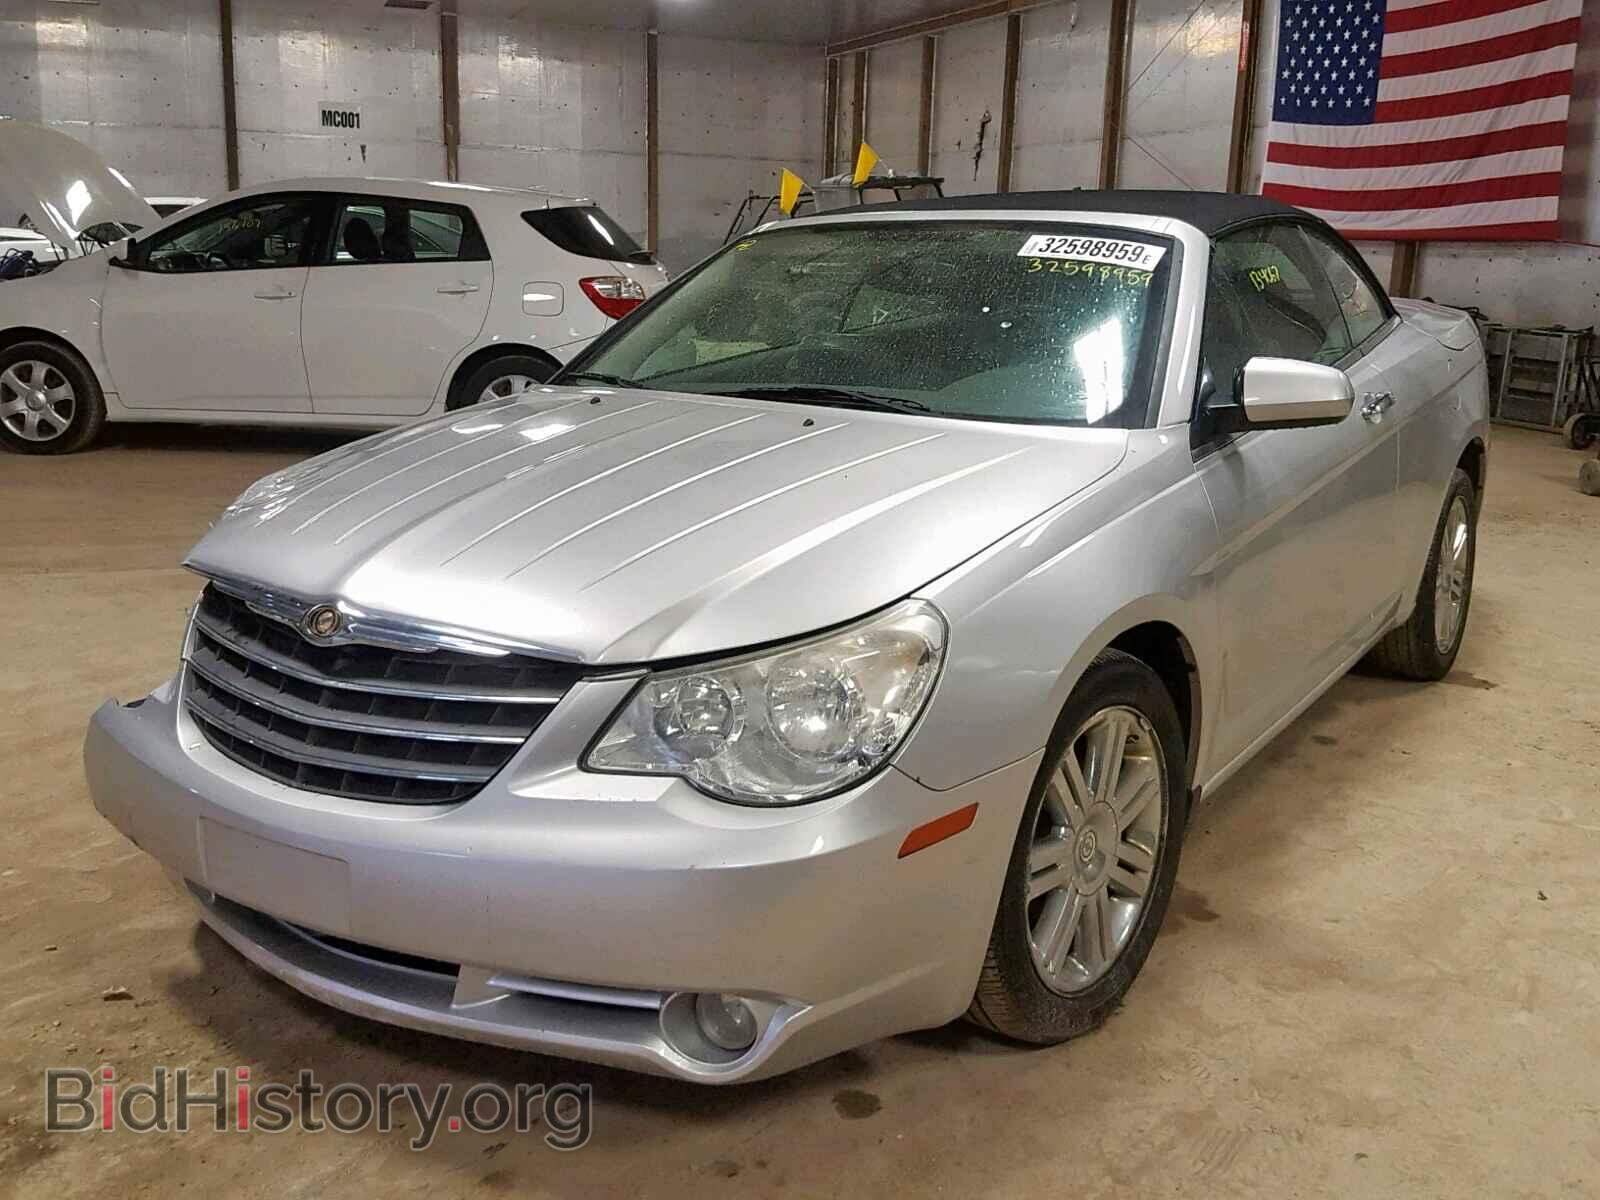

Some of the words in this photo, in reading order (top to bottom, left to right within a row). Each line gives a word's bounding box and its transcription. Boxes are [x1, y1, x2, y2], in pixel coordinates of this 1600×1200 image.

[321, 110, 360, 129] MC001
[1038, 237, 1145, 263] 32598959
[1027, 257, 1154, 287] 32598959
